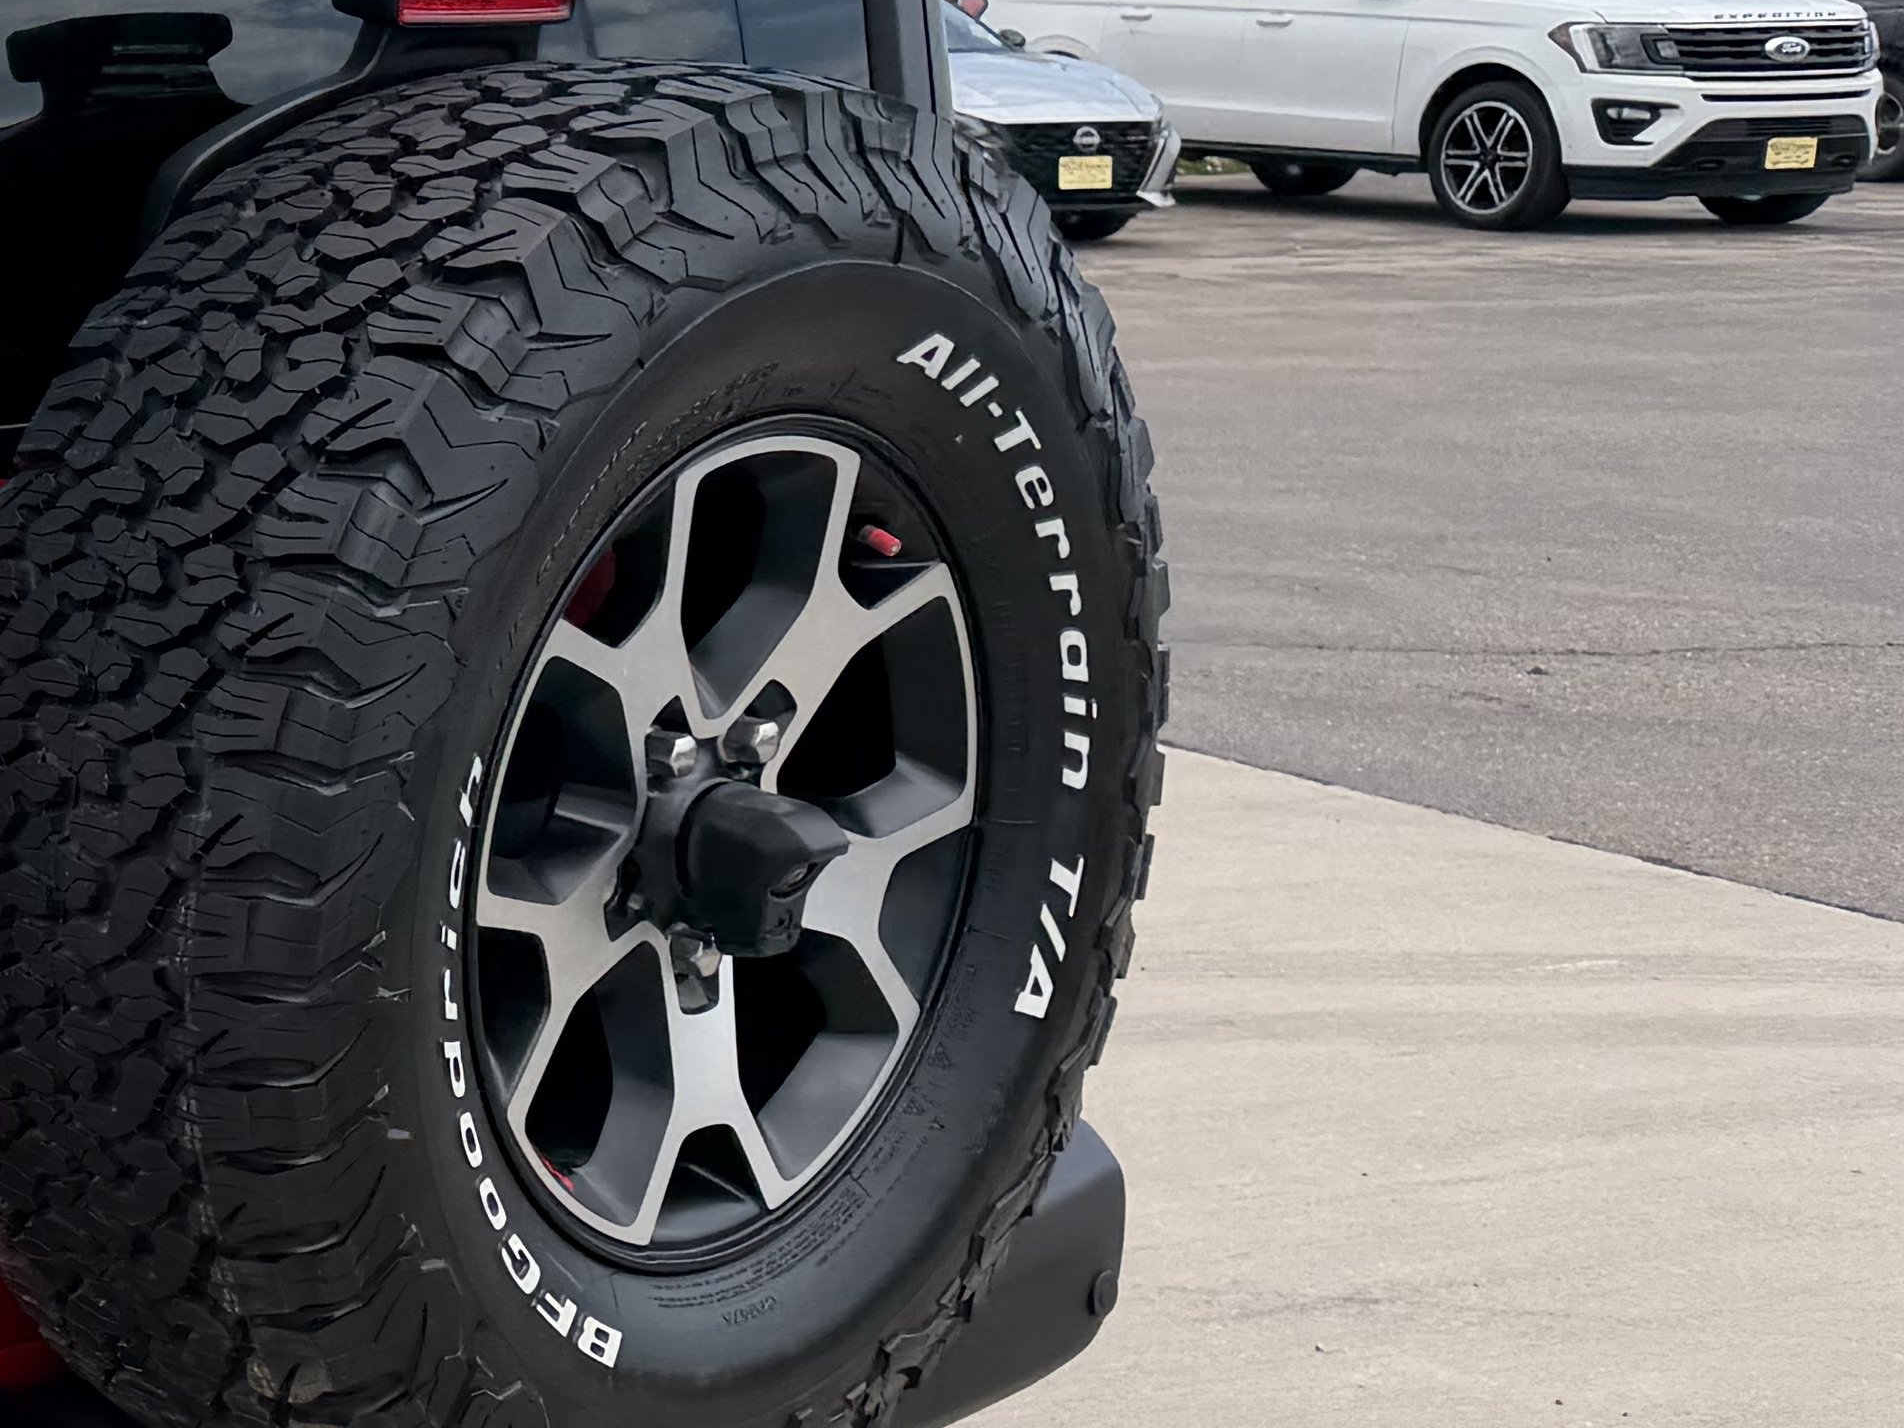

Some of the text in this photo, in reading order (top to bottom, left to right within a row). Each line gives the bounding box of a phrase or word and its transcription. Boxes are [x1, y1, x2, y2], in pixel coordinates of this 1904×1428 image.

[1713, 11, 1837, 20] EXPEDITION
[896, 332, 1099, 1019] All-Terrain T/A
[440, 752, 623, 1370] BFGoodrich
